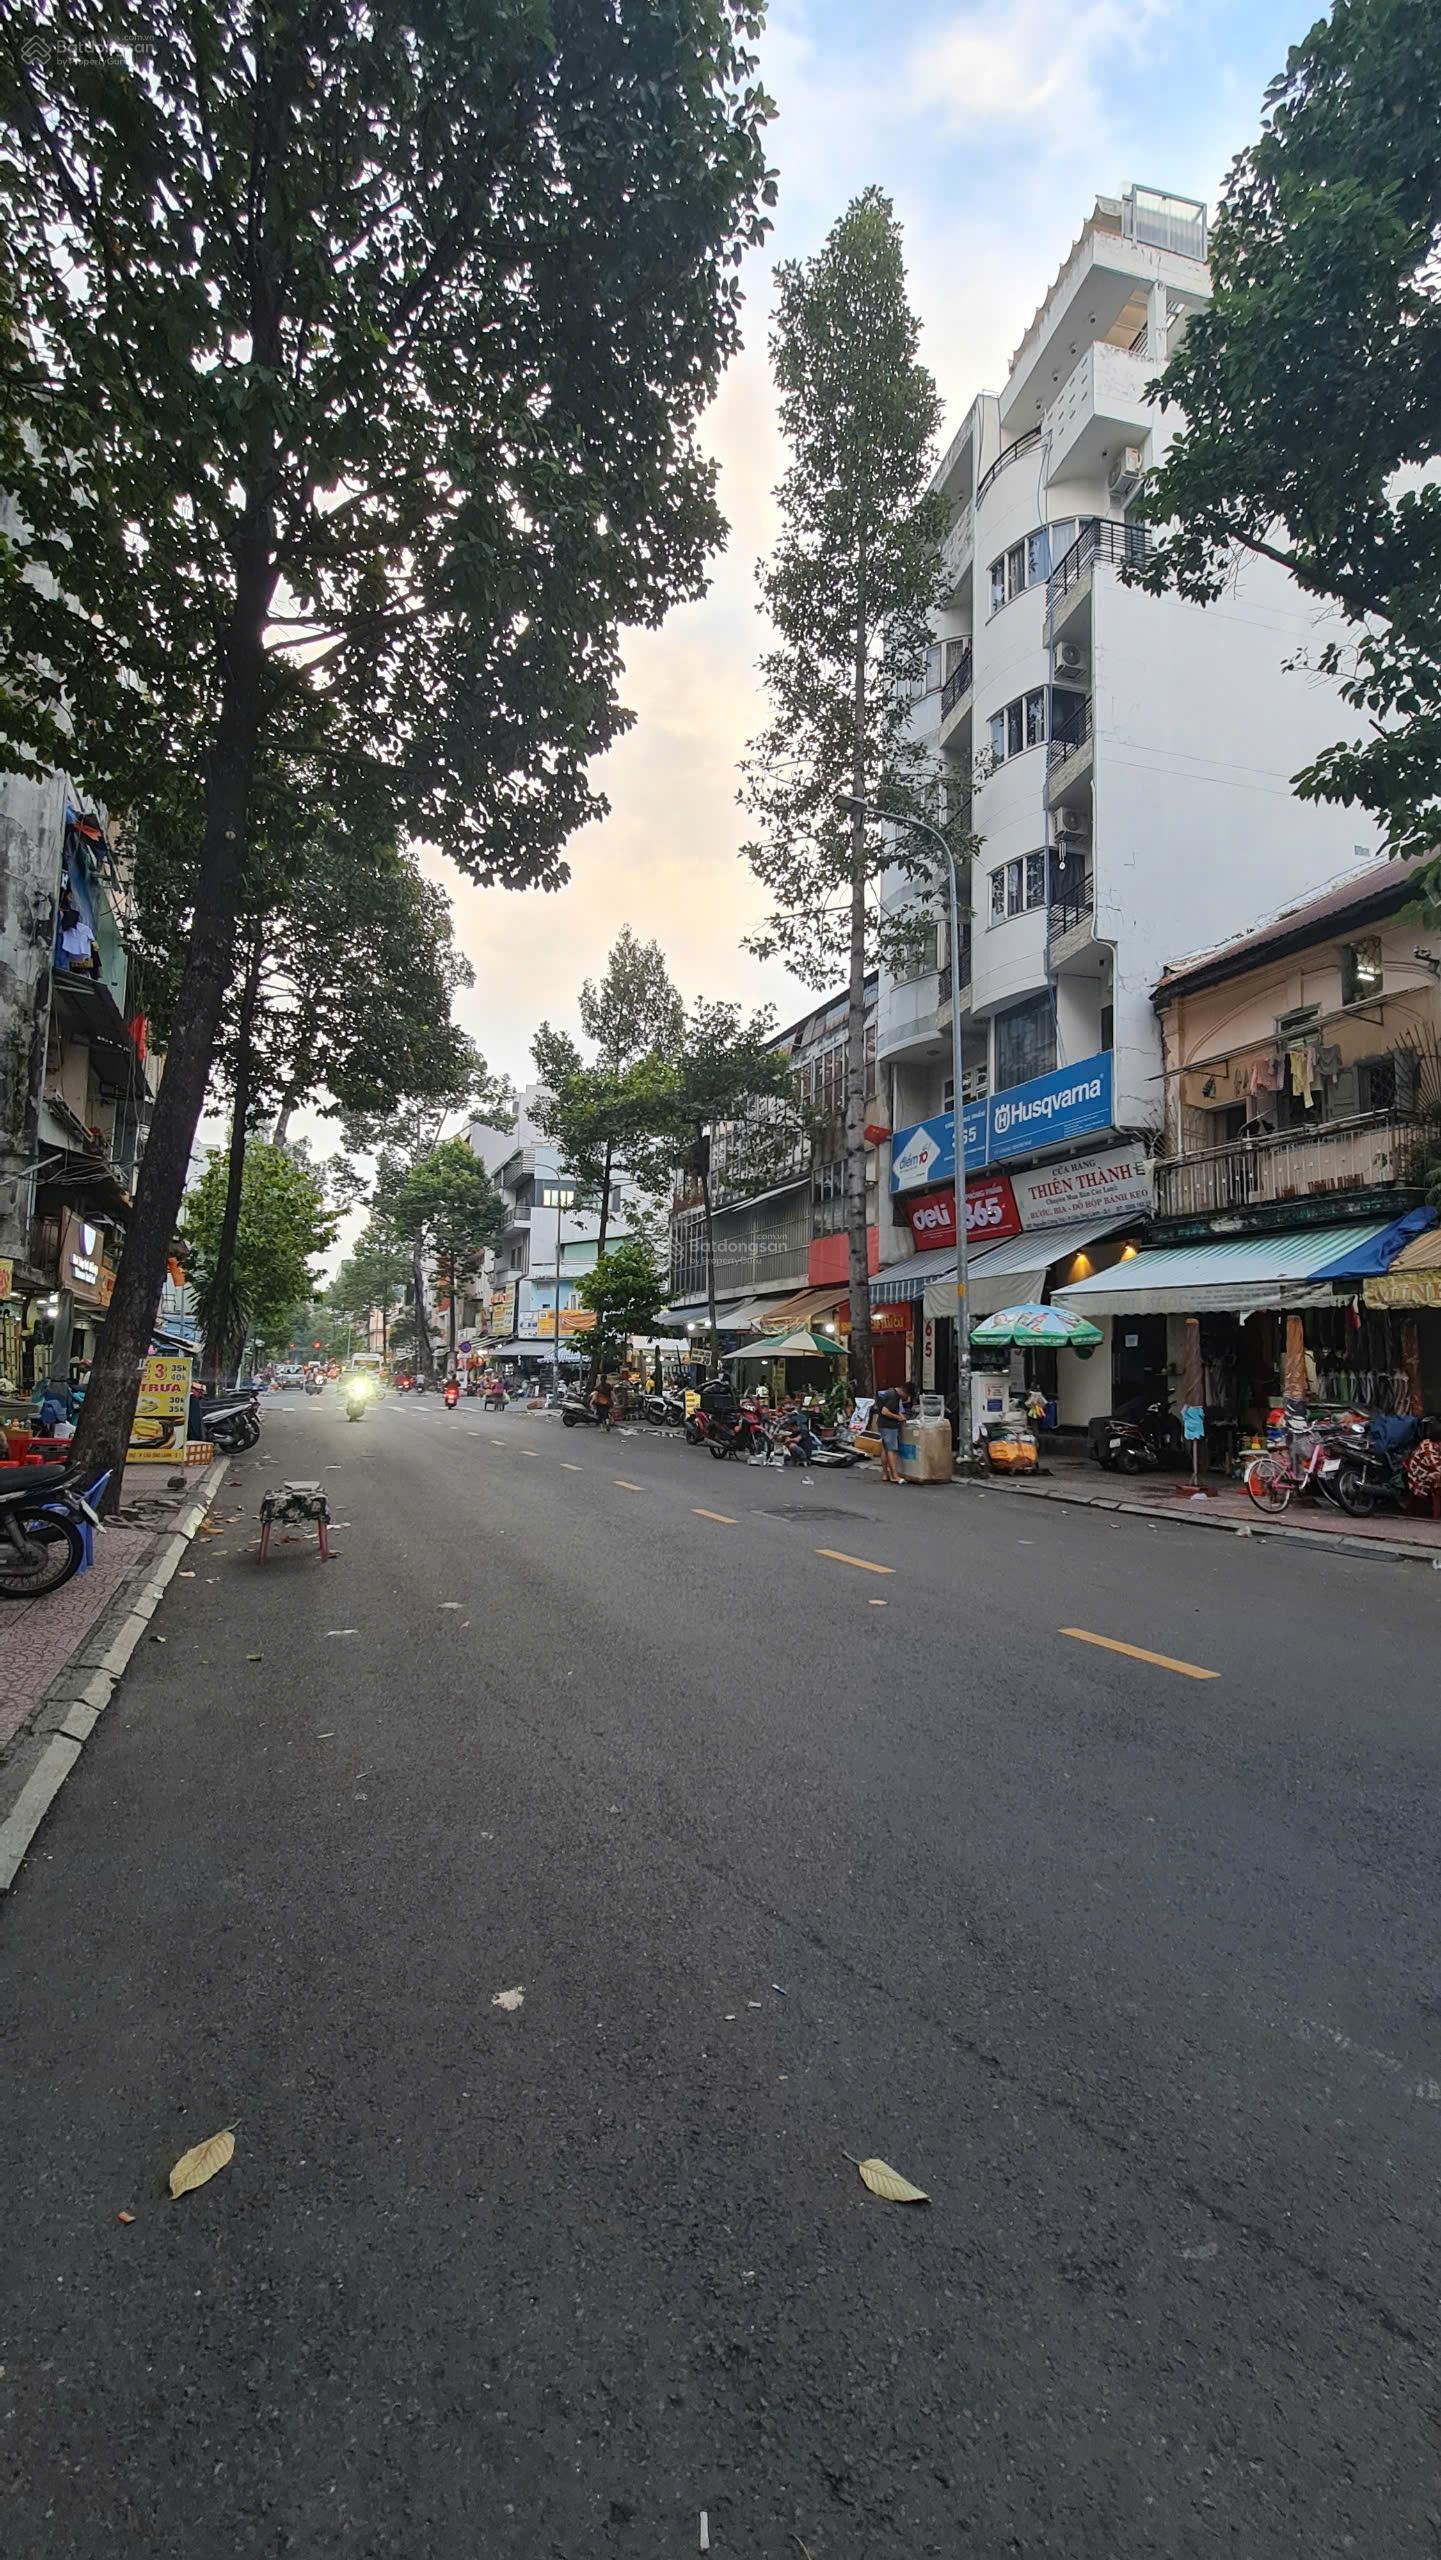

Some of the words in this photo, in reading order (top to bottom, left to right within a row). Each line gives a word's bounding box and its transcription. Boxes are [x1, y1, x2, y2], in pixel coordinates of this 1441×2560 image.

[1011, 1078, 1101, 1125] Husqvarna
[1071, 1159, 1096, 1173] HÀNG
[1028, 1177, 1073, 1200] THIÊN
[1075, 1164, 1133, 1190] THÀNH
[1130, 1189, 1149, 1201] KẸO
[912, 1203, 951, 1231] deli
[155, 1363, 165, 1379] 3
